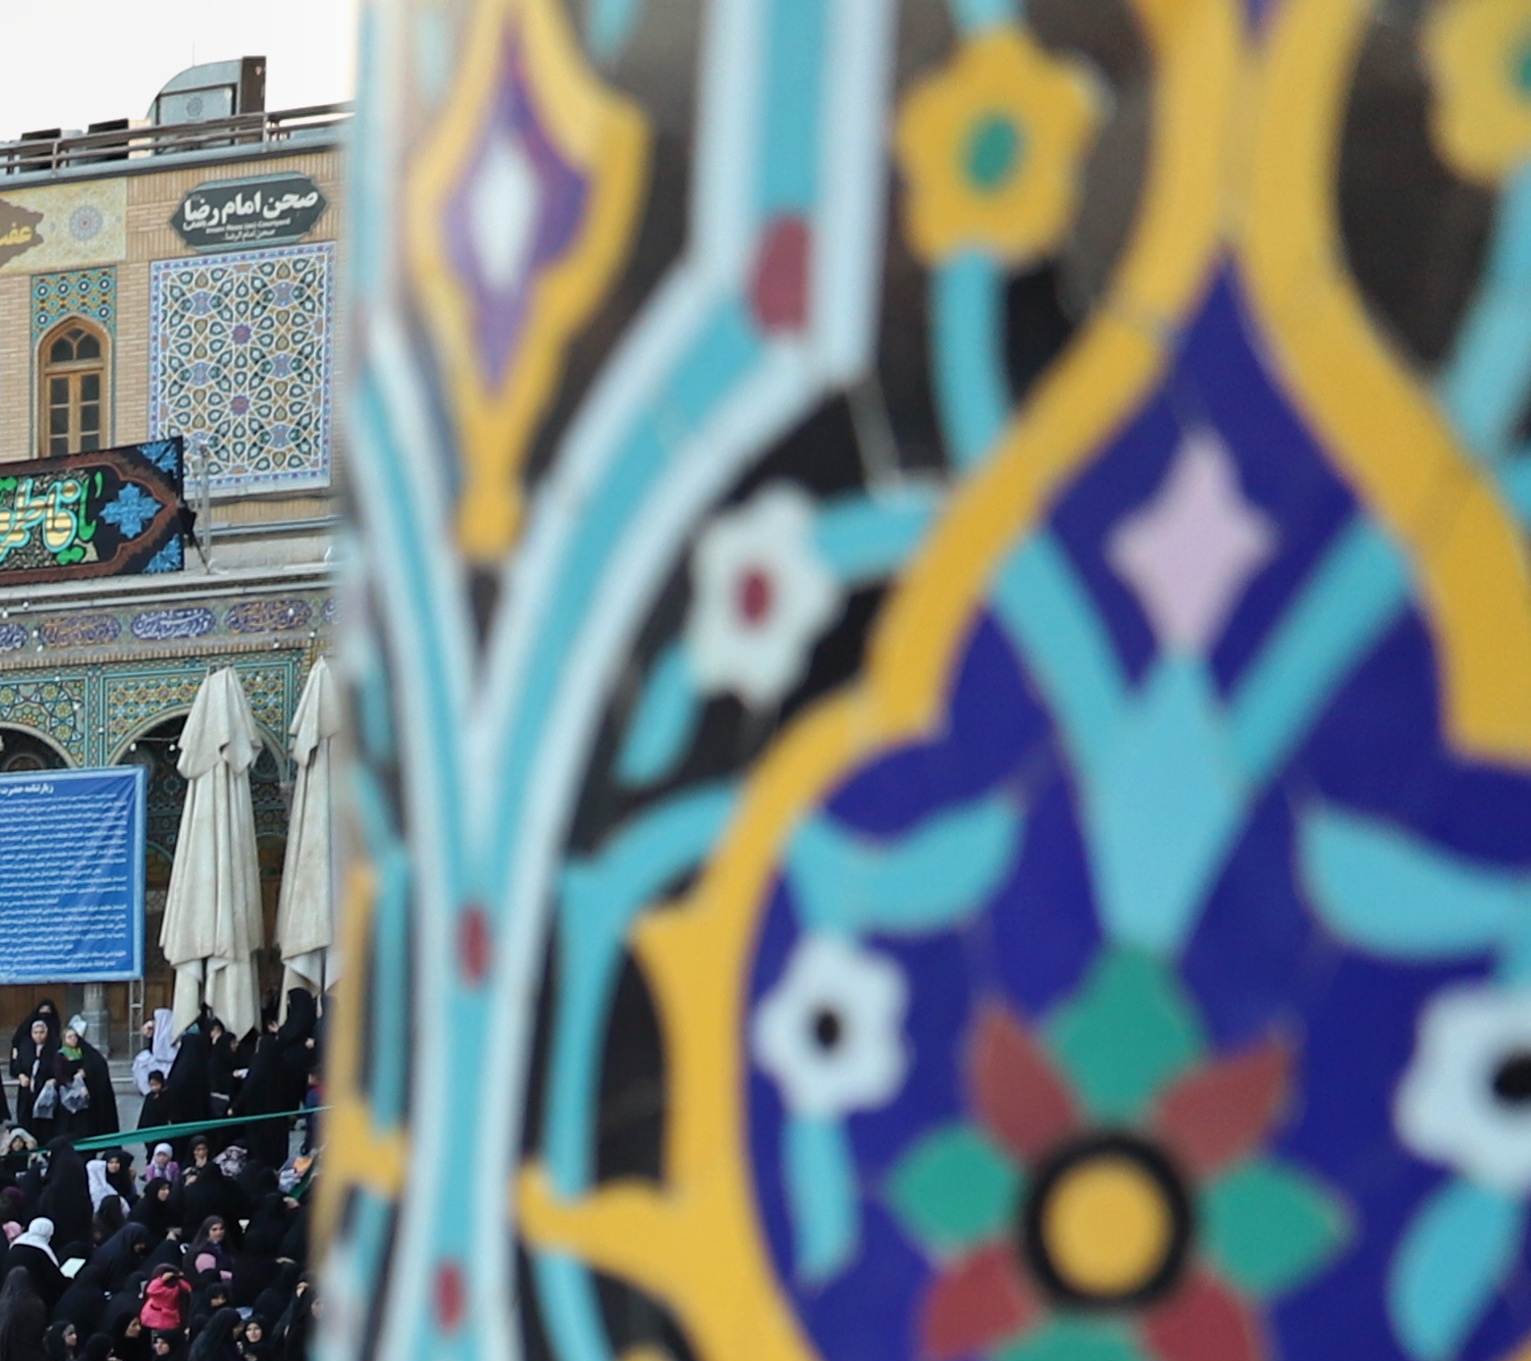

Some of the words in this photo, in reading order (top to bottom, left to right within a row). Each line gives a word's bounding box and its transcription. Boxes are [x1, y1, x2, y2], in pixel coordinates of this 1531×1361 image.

[183, 198, 220, 226] رضا
[221, 190, 262, 225] امام
[262, 190, 319, 219] صحن
